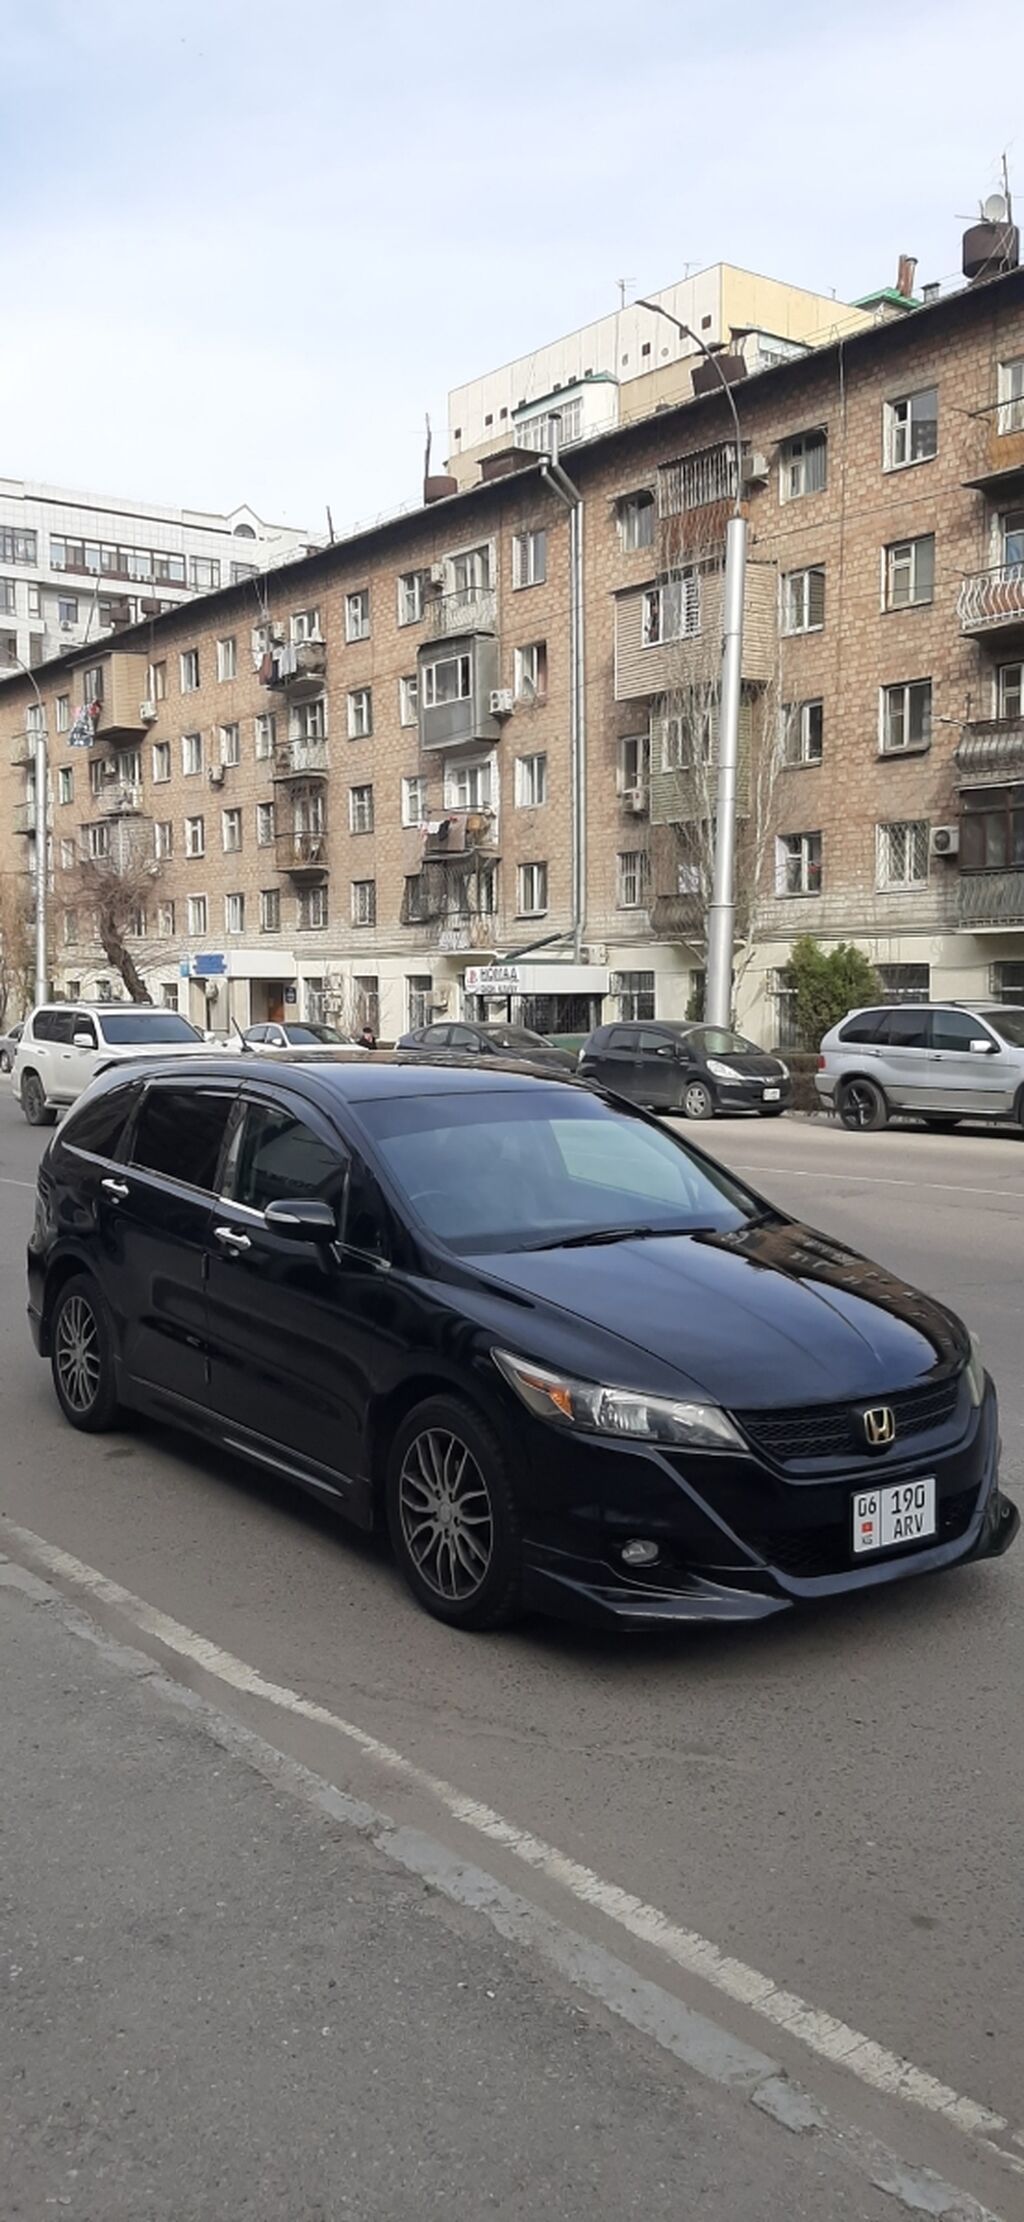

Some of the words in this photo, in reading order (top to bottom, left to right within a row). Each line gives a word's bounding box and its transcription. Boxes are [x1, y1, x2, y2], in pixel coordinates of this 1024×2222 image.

[858, 1496, 877, 1517] 06
[891, 1484, 925, 1515] 190
[894, 1513, 924, 1539] ARV
